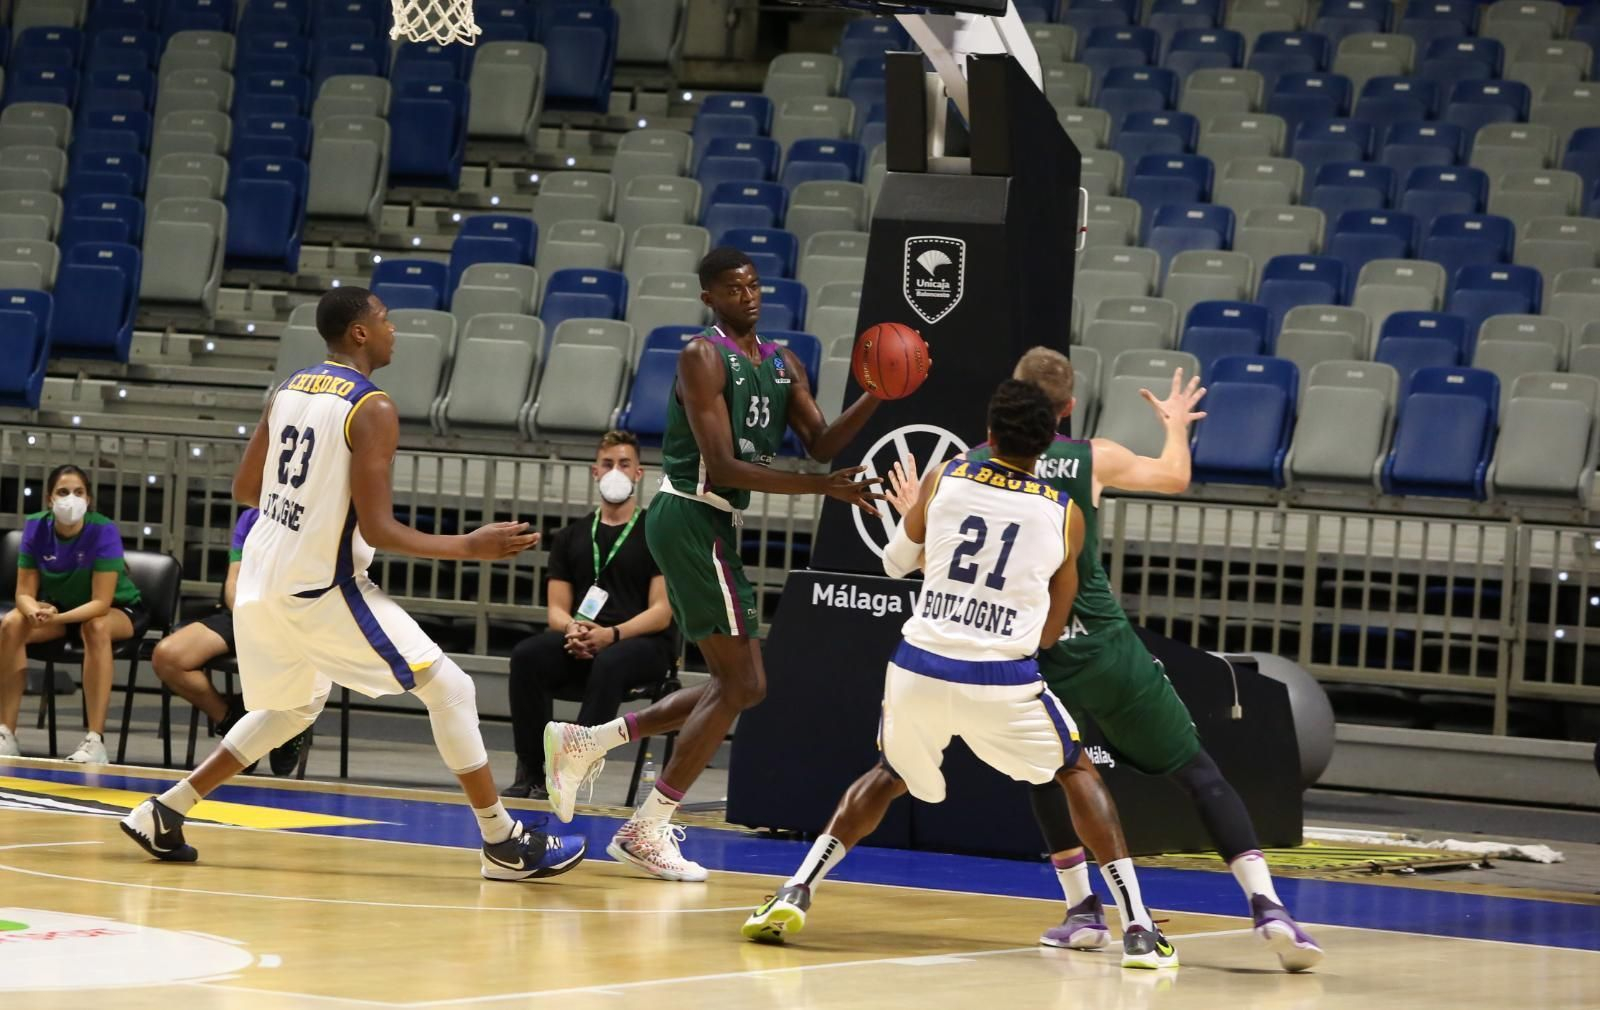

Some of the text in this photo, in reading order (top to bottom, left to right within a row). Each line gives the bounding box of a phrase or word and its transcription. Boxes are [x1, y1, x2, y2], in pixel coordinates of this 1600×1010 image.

[916, 278, 950, 290] Unicaja
[288, 374, 355, 397] CHIKOKO
[745, 395, 771, 429] 33
[277, 425, 316, 489] 23
[951, 463, 1060, 502] A.BROWN
[948, 515, 1020, 591] 21
[812, 582, 902, 617] Málaga
[922, 590, 1017, 637] BOULOGNE
